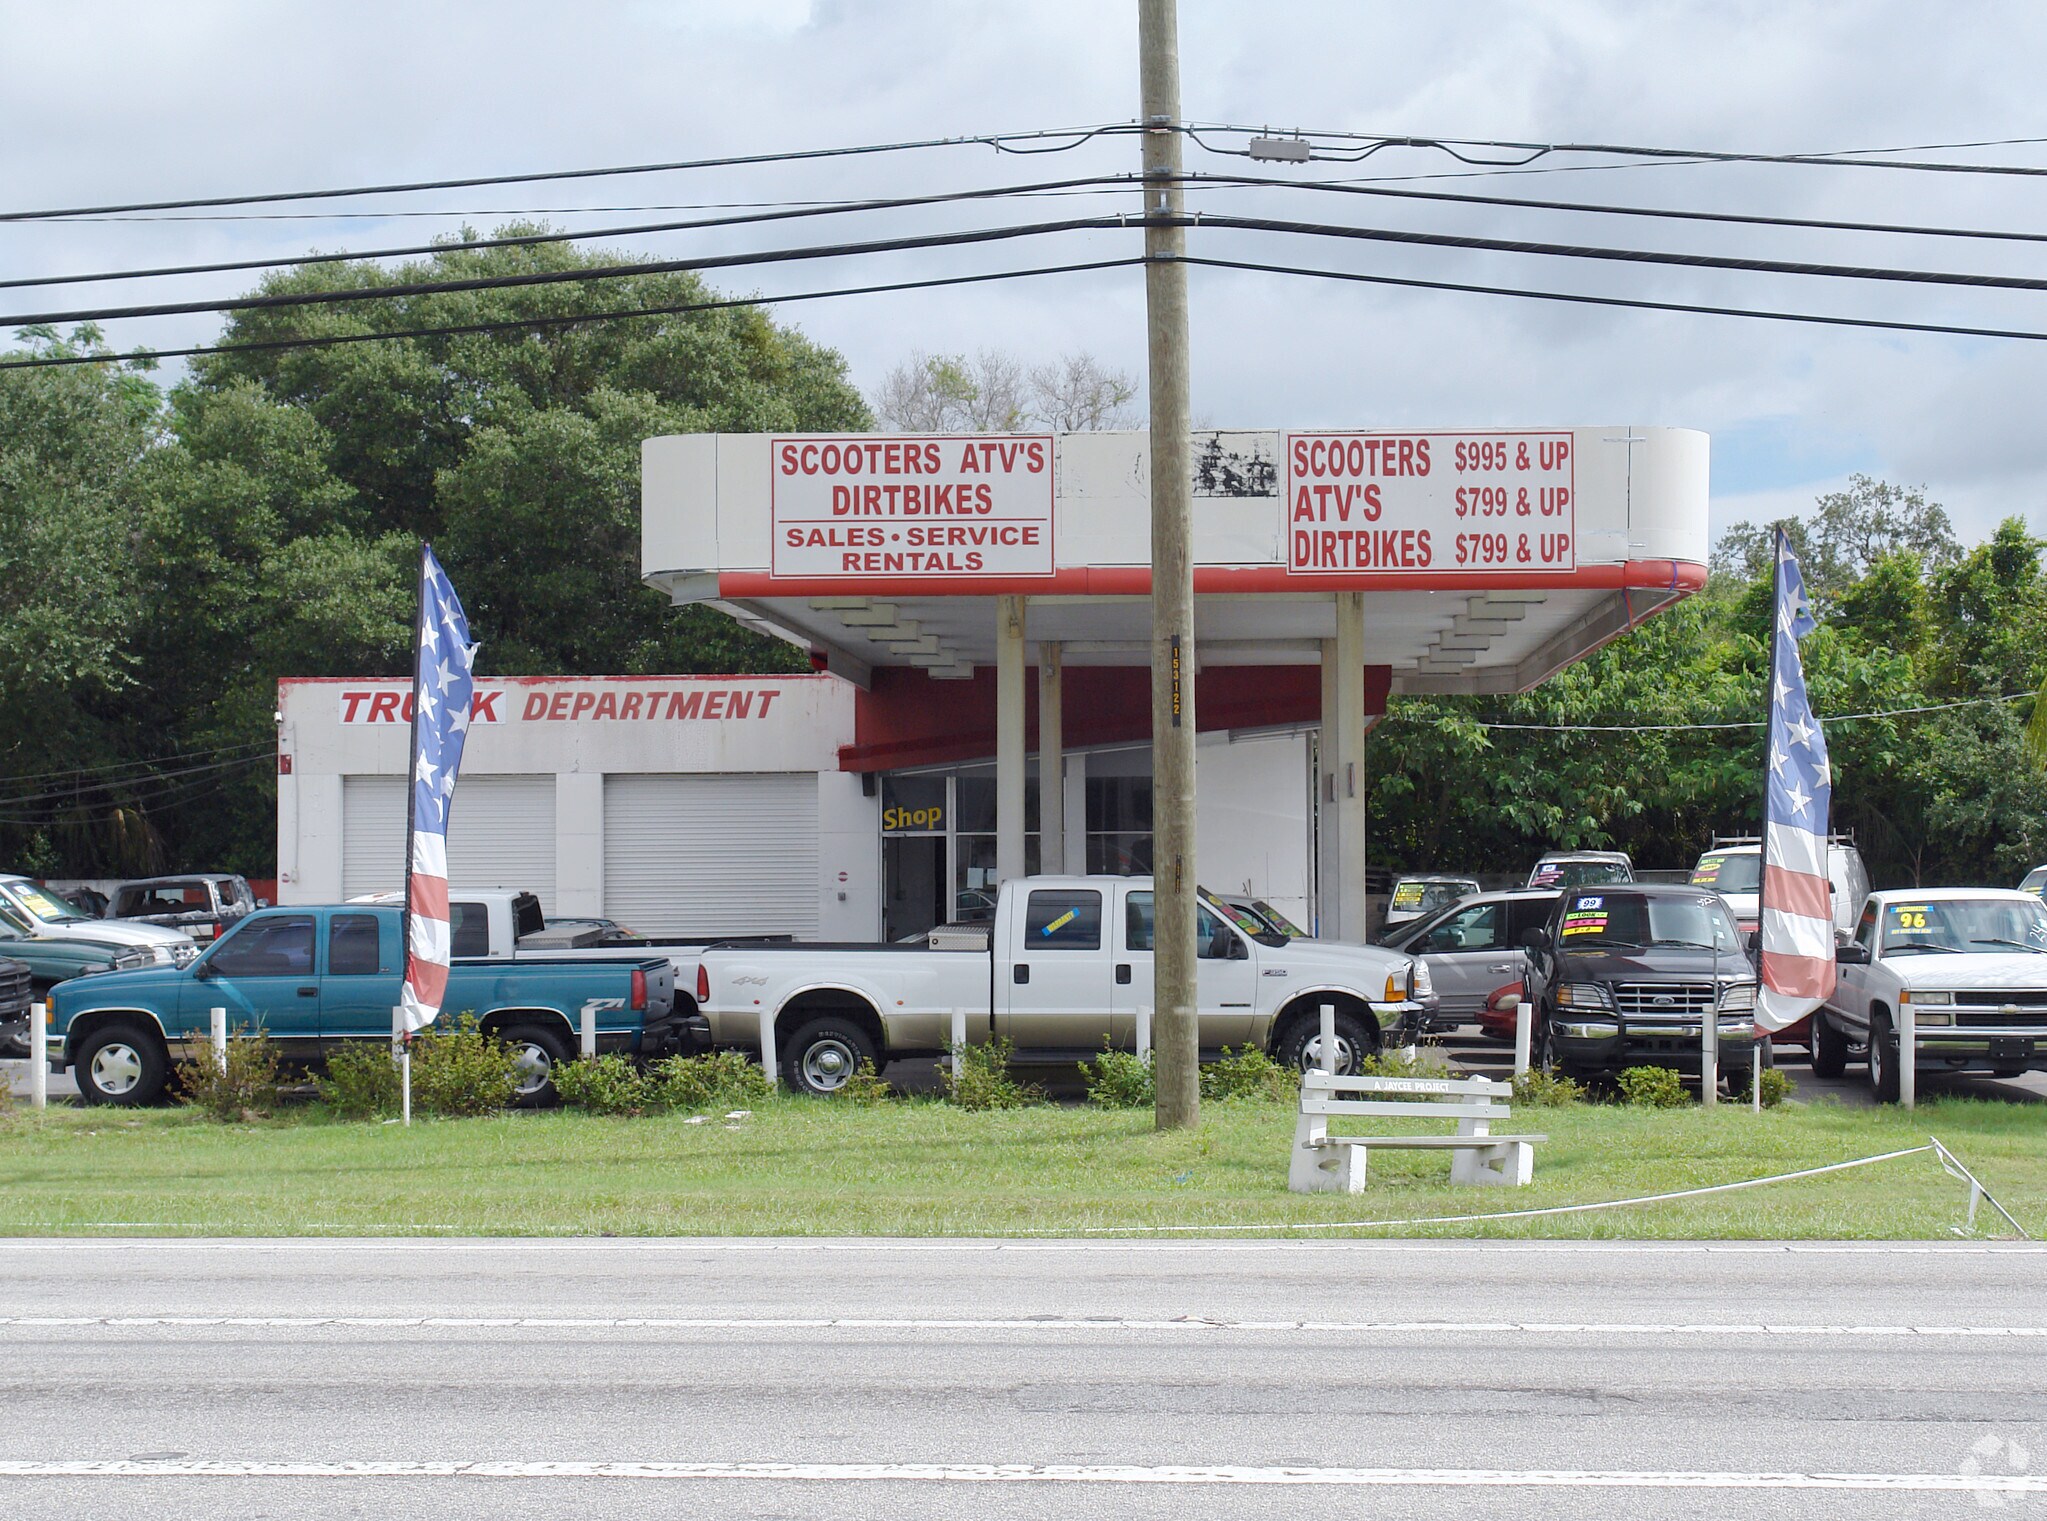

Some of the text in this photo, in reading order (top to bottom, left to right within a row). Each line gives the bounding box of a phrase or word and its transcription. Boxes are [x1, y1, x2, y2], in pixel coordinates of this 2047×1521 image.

[781, 442, 1044, 476] SCOOTERS ATV'S
[1294, 439, 1569, 477] SCOOTERS $995 & UP
[832, 483, 992, 516] DIRTBIKES
[1294, 484, 1569, 522] ATV'S $799 & UP
[787, 526, 1039, 547] SALES SERVICE
[1294, 530, 1570, 568] DIRTBIKES $799 & UP
[842, 551, 984, 571] RENTALS
[1172, 648, 1181, 714] 153122
[342, 690, 780, 723] TRK DEPARTMENT
[883, 806, 942, 831] Shop
[1582, 899, 1597, 908] 99
[1900, 912, 1926, 928] 96
[1373, 1081, 1449, 1092] A JAYCEE PROJECT
